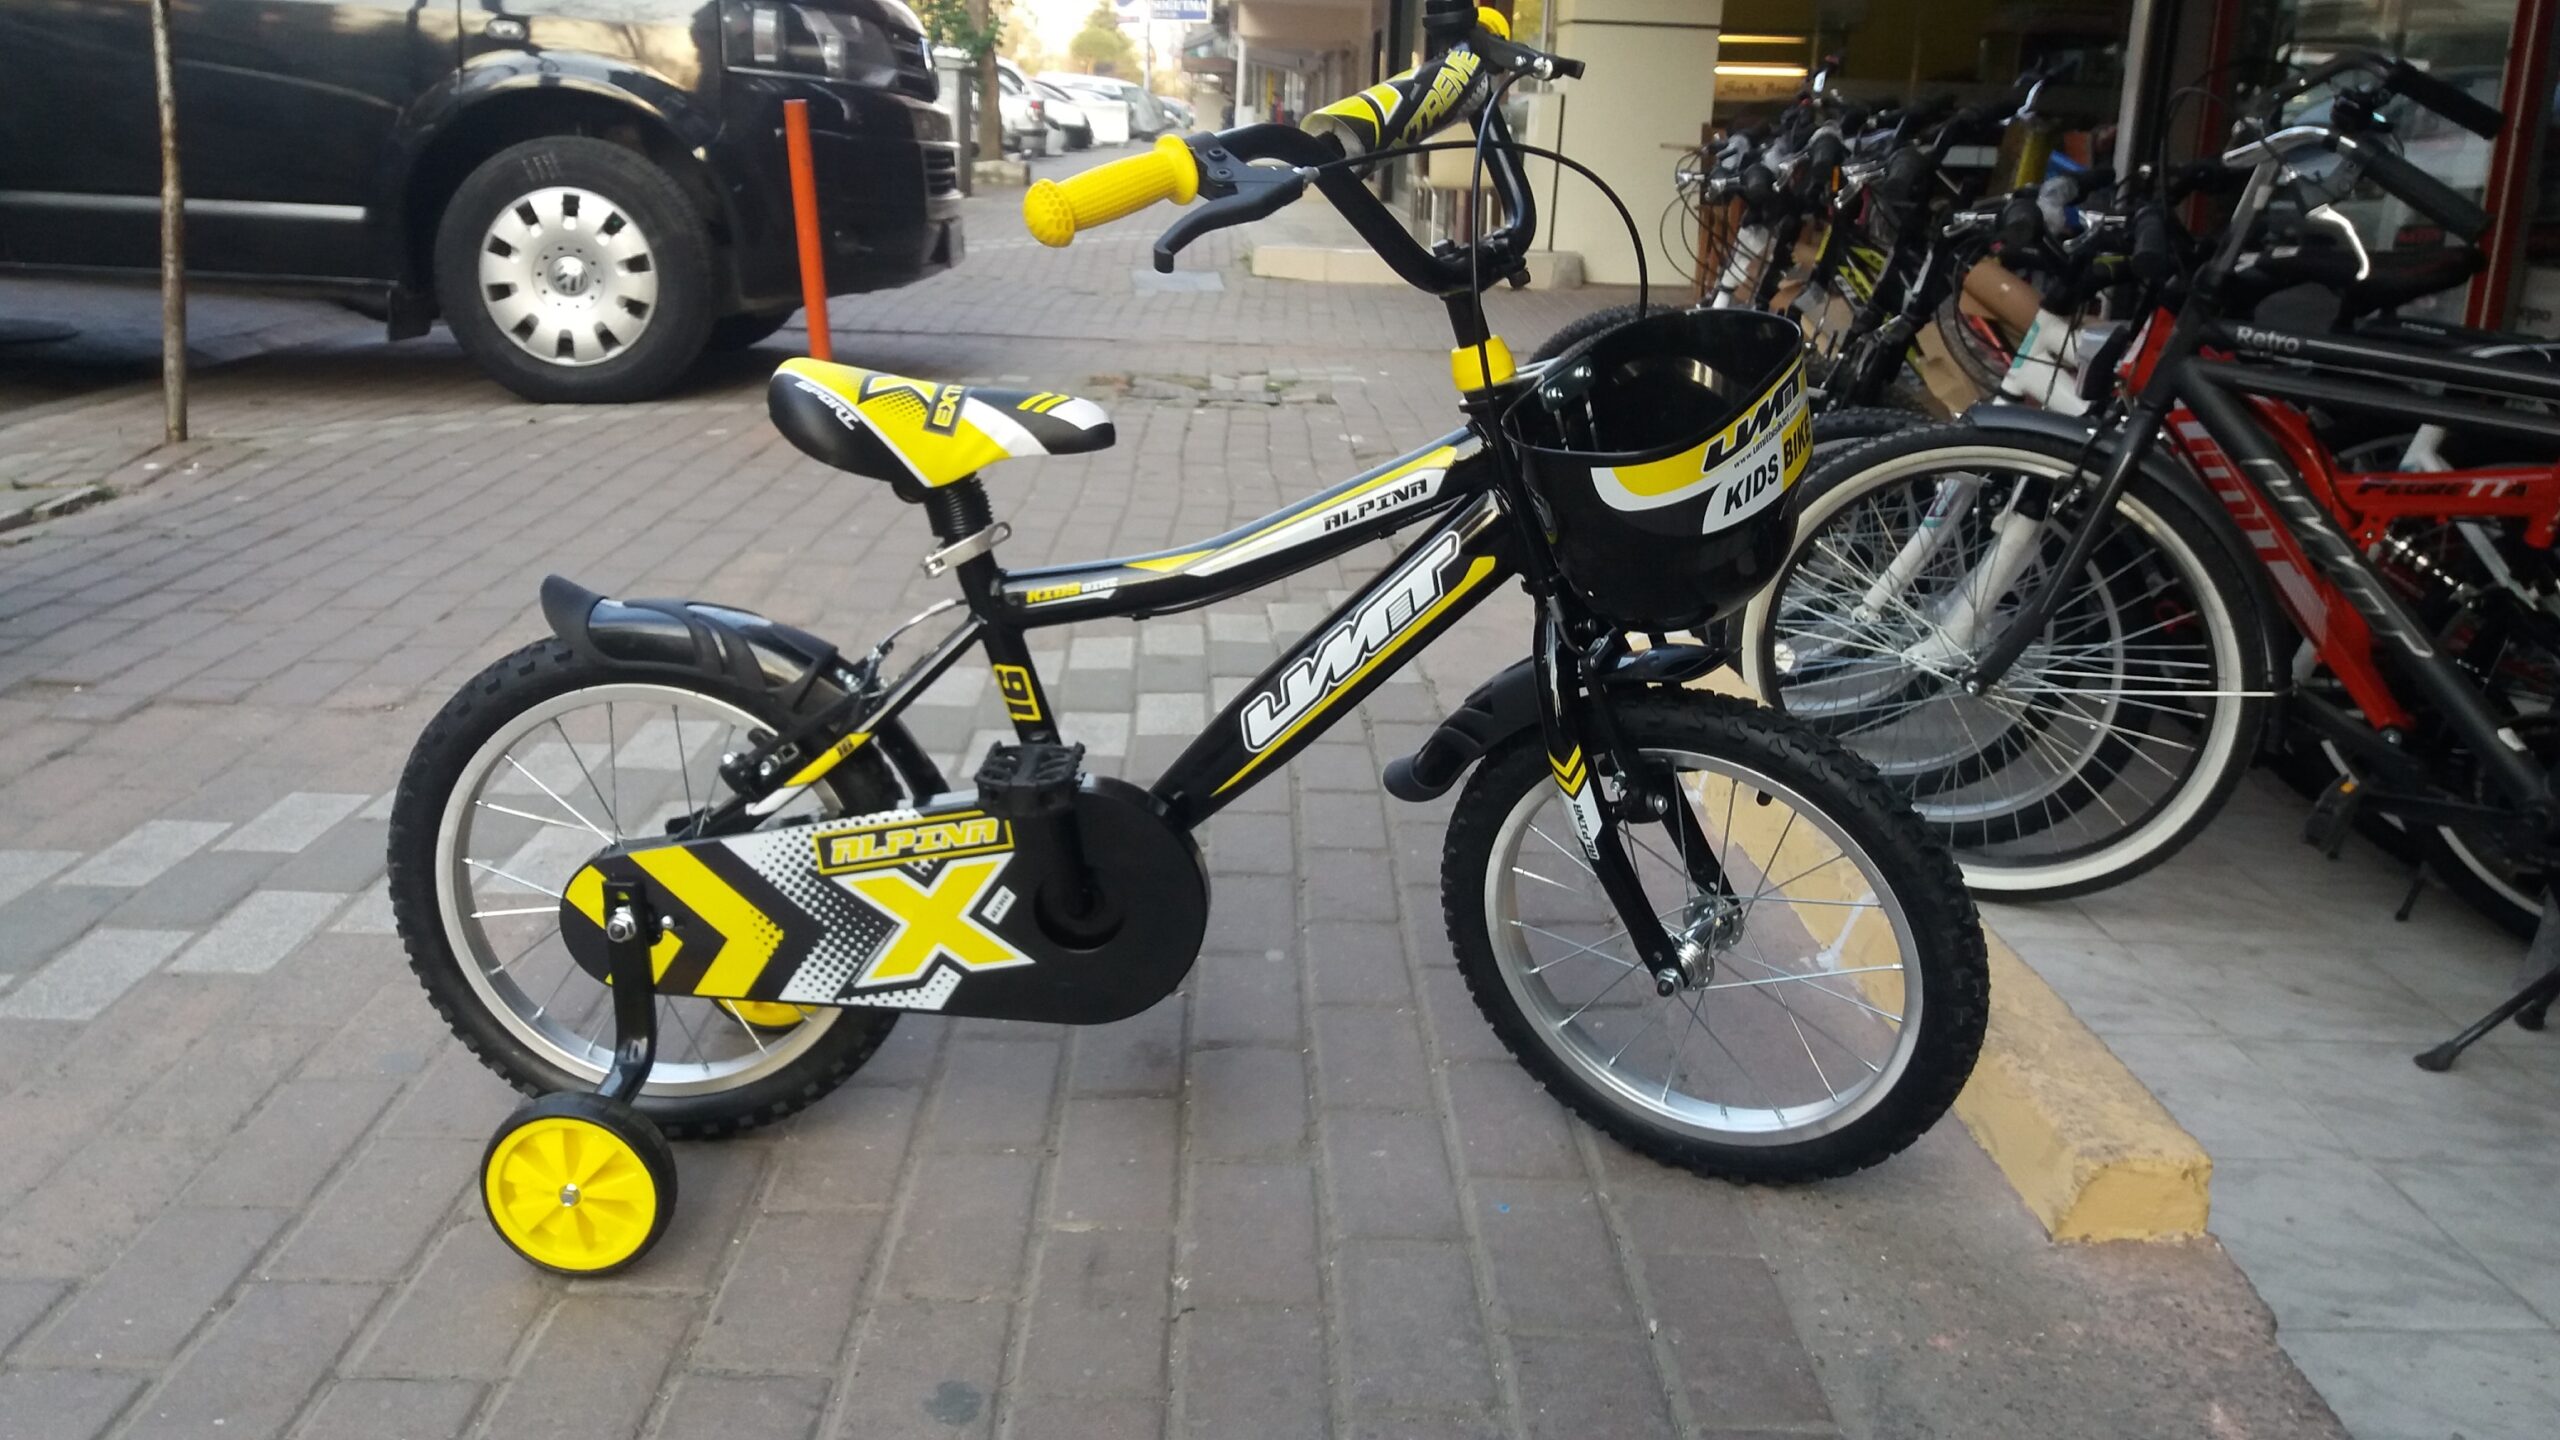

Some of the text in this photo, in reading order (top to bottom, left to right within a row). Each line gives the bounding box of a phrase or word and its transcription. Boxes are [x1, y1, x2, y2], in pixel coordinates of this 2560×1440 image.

[2236, 325, 2300, 353] Retro
[1724, 411, 1811, 517] KIDS BIKE
[1323, 478, 1428, 532] ALPINA
[1025, 581, 1082, 604] KIDS
[831, 817, 999, 865] ALPINA
[1572, 803, 1599, 859] ALPINA
[830, 852, 1036, 988] X
